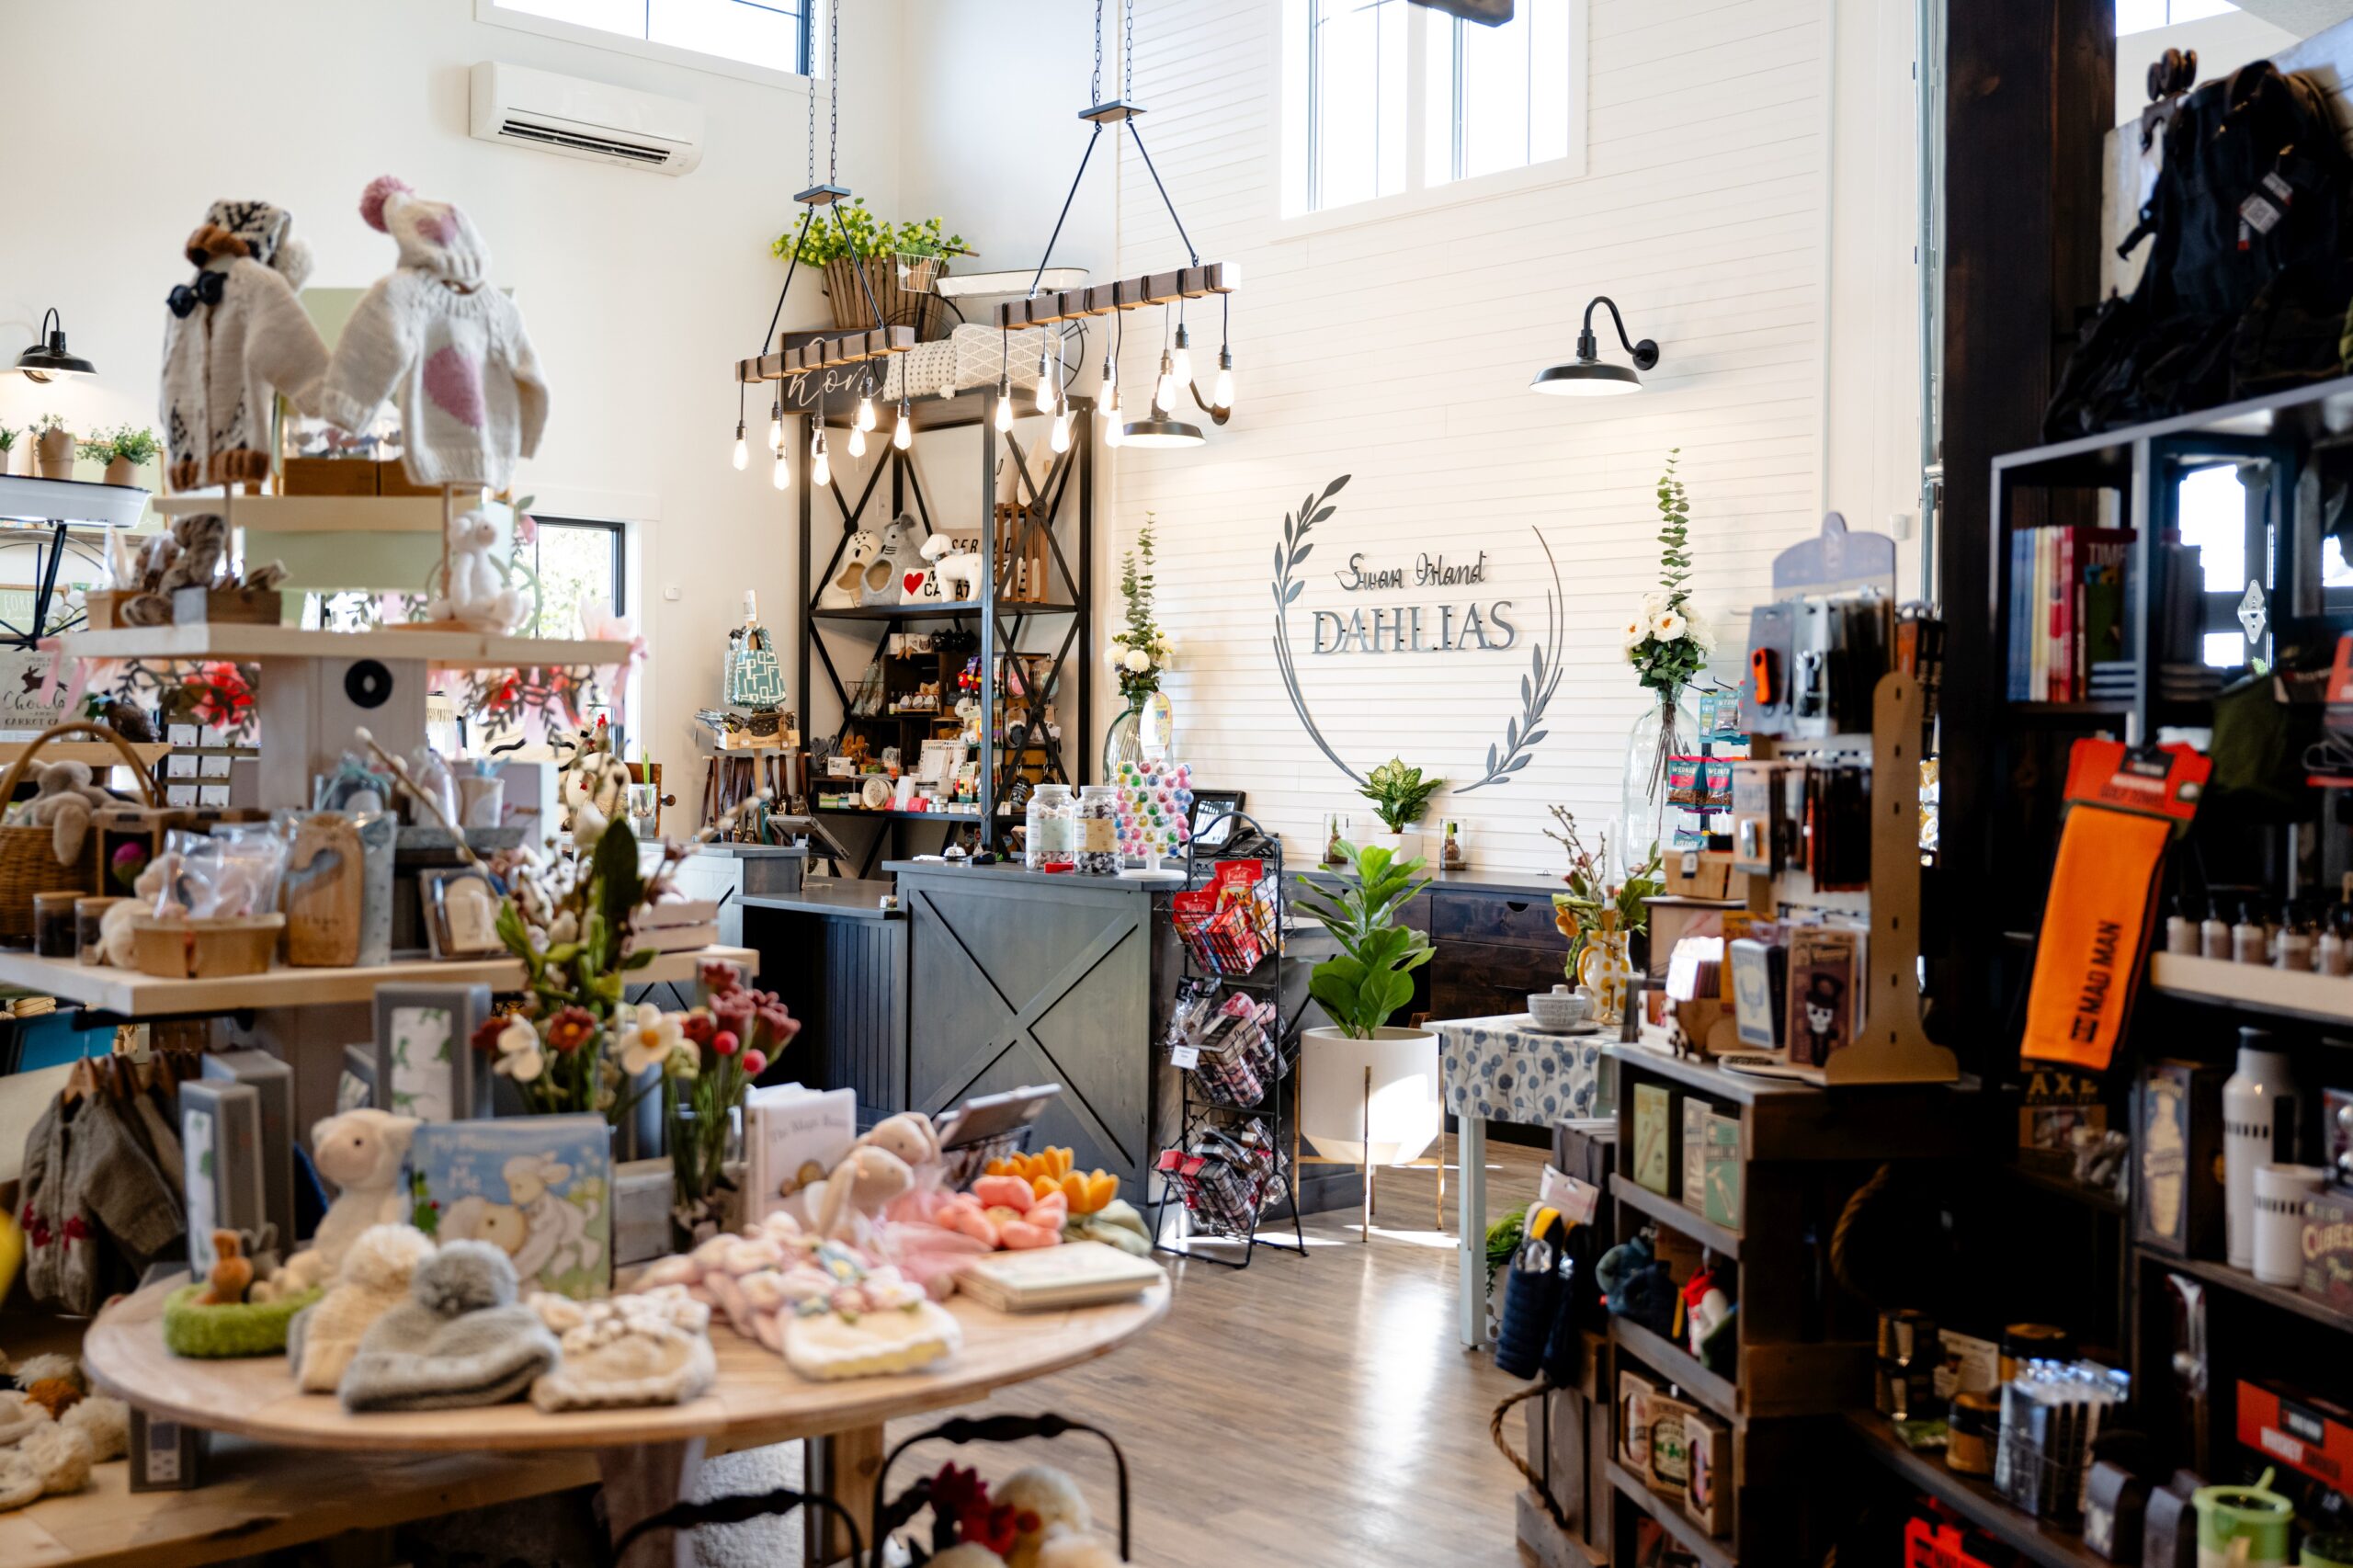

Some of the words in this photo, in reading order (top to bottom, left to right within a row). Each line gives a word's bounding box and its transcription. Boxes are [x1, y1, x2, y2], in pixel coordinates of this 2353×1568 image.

[1334, 552, 1405, 591] Swan
[1413, 551, 1486, 586] Island
[1312, 600, 1516, 654] DAHLIAS
[2090, 919, 2122, 971] MAN
[2077, 971, 2112, 1016] MAD
